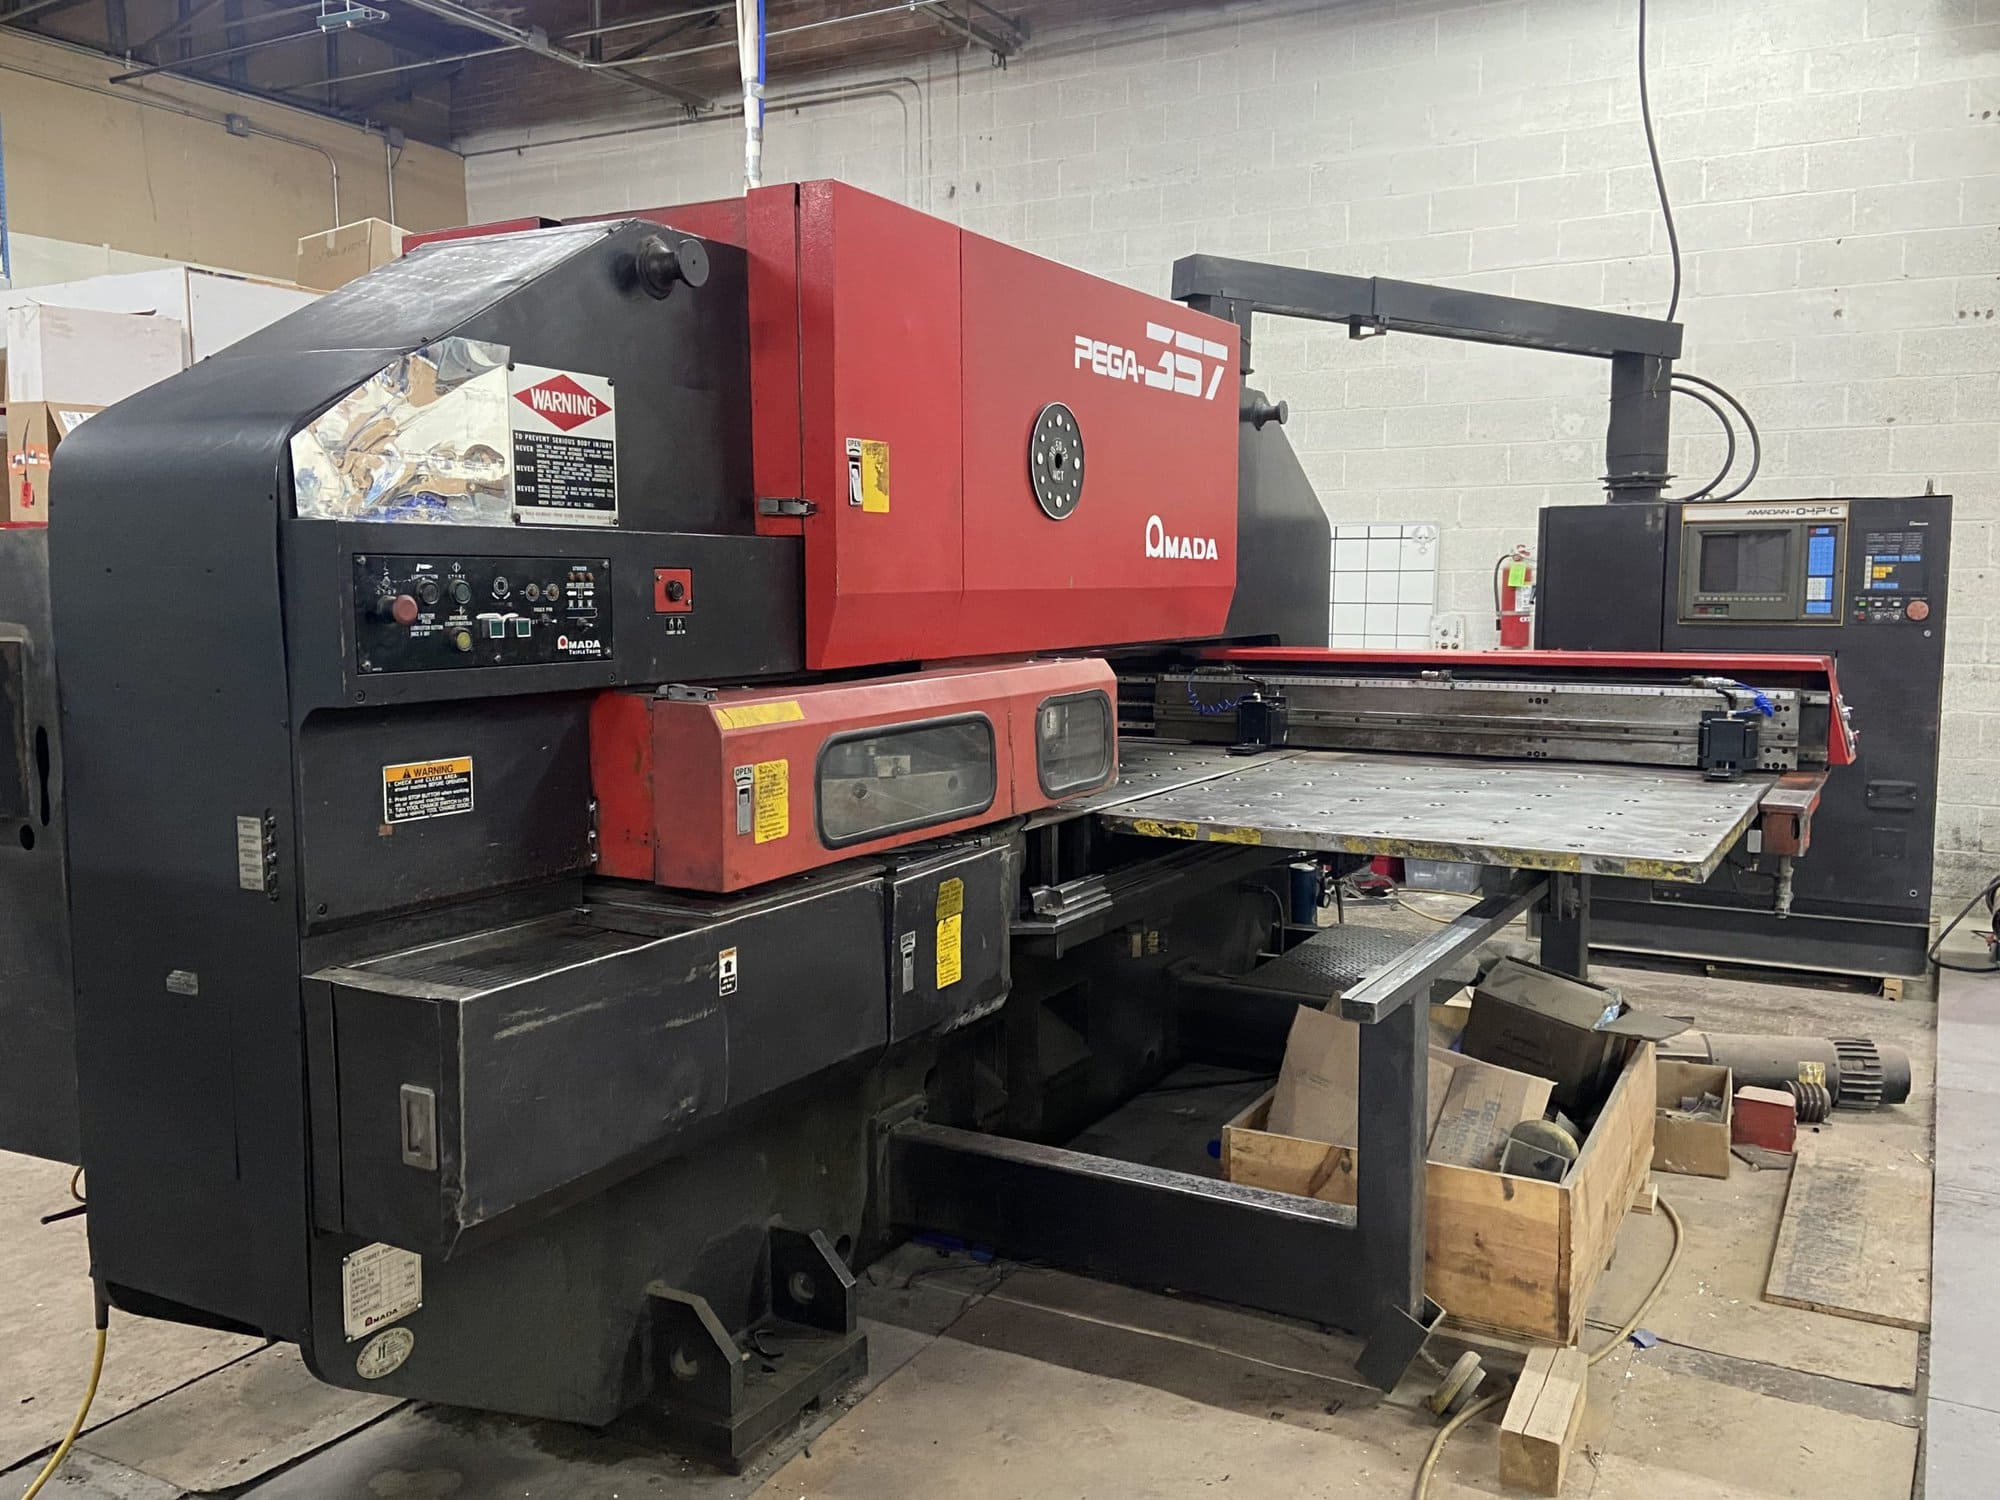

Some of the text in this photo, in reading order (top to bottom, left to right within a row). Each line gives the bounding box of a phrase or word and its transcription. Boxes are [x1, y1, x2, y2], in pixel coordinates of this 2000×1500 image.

[530, 388, 596, 417] WARNING
[515, 432, 522, 440] TO
[524, 434, 549, 443] PREVENT
[552, 437, 575, 446] SERIOUS
[593, 441, 612, 449] INJURY
[515, 444, 534, 452] NEVER
[516, 465, 535, 473] NEVER
[516, 485, 535, 493] NEVER
[1145, 514, 1219, 560] AMADA
[557, 635, 601, 650] AMADA
[413, 765, 454, 777] WARNING
[735, 766, 752, 777] OPEN
[421, 791, 440, 799] BUTTON
[902, 934, 914, 943] OPEN
[365, 1308, 398, 1327] AMADA
